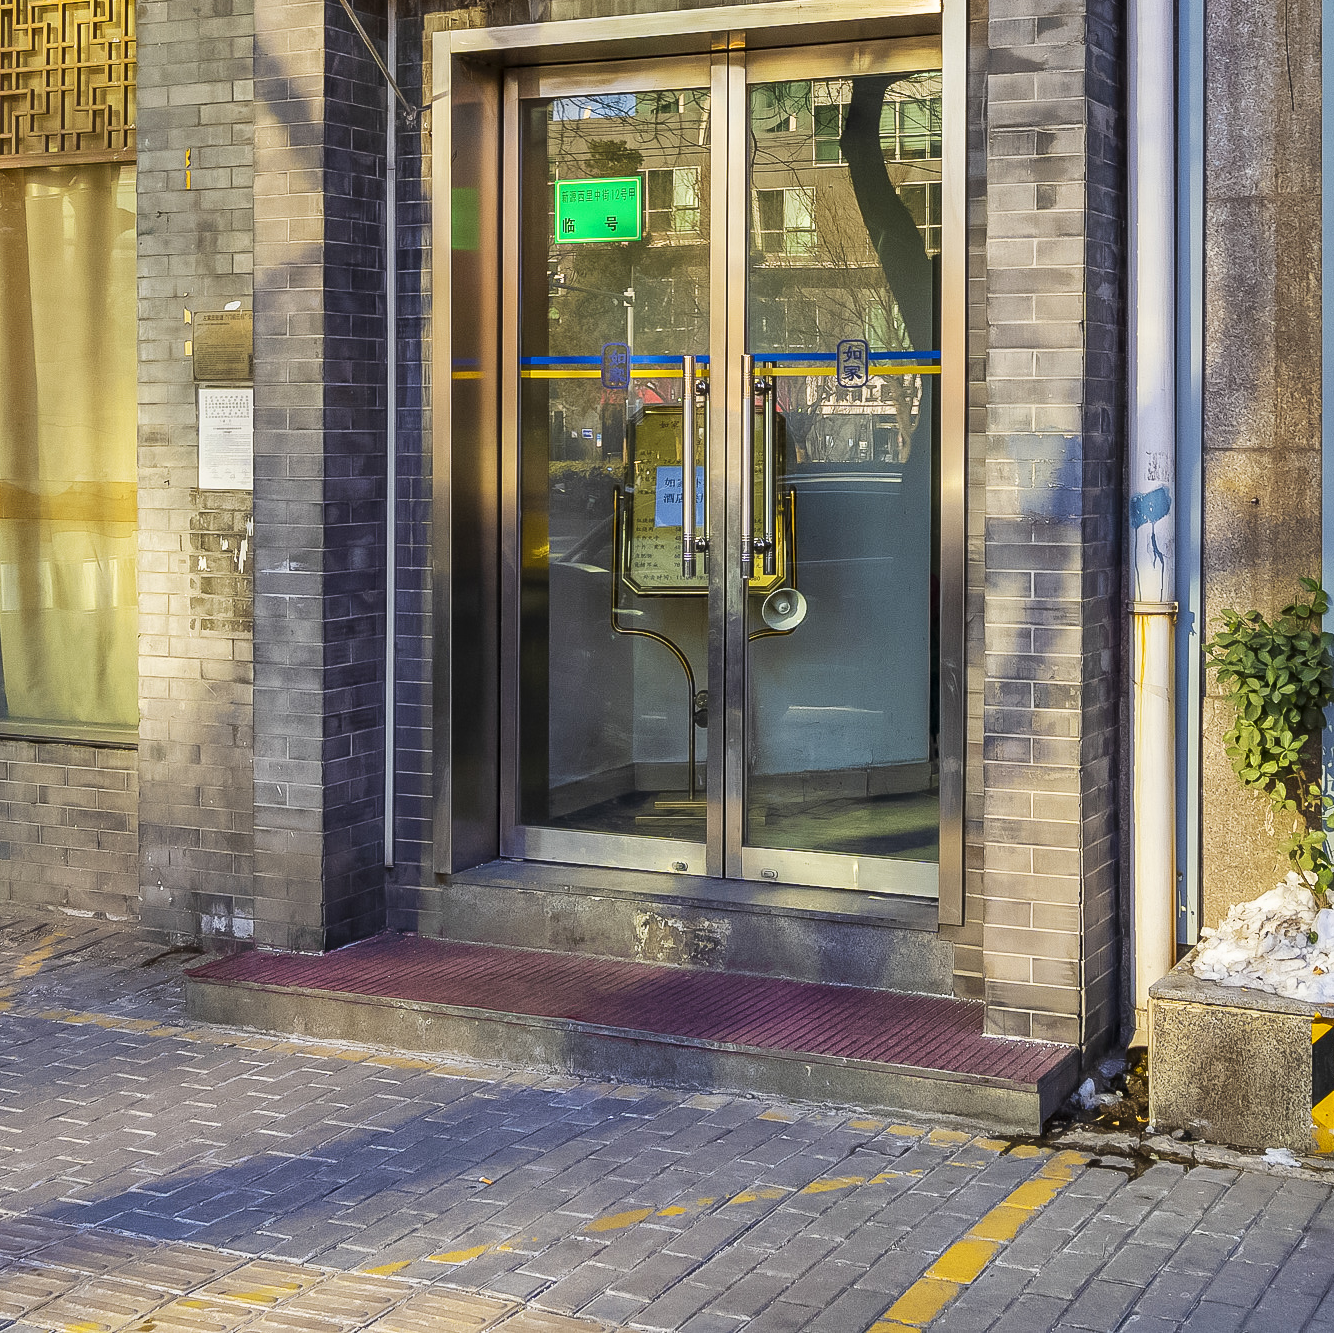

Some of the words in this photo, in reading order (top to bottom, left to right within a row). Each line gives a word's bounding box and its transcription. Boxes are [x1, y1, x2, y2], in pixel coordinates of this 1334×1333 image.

[562, 217, 576, 234] 临
[604, 215, 619, 232] 号
[842, 345, 864, 382] 如家
